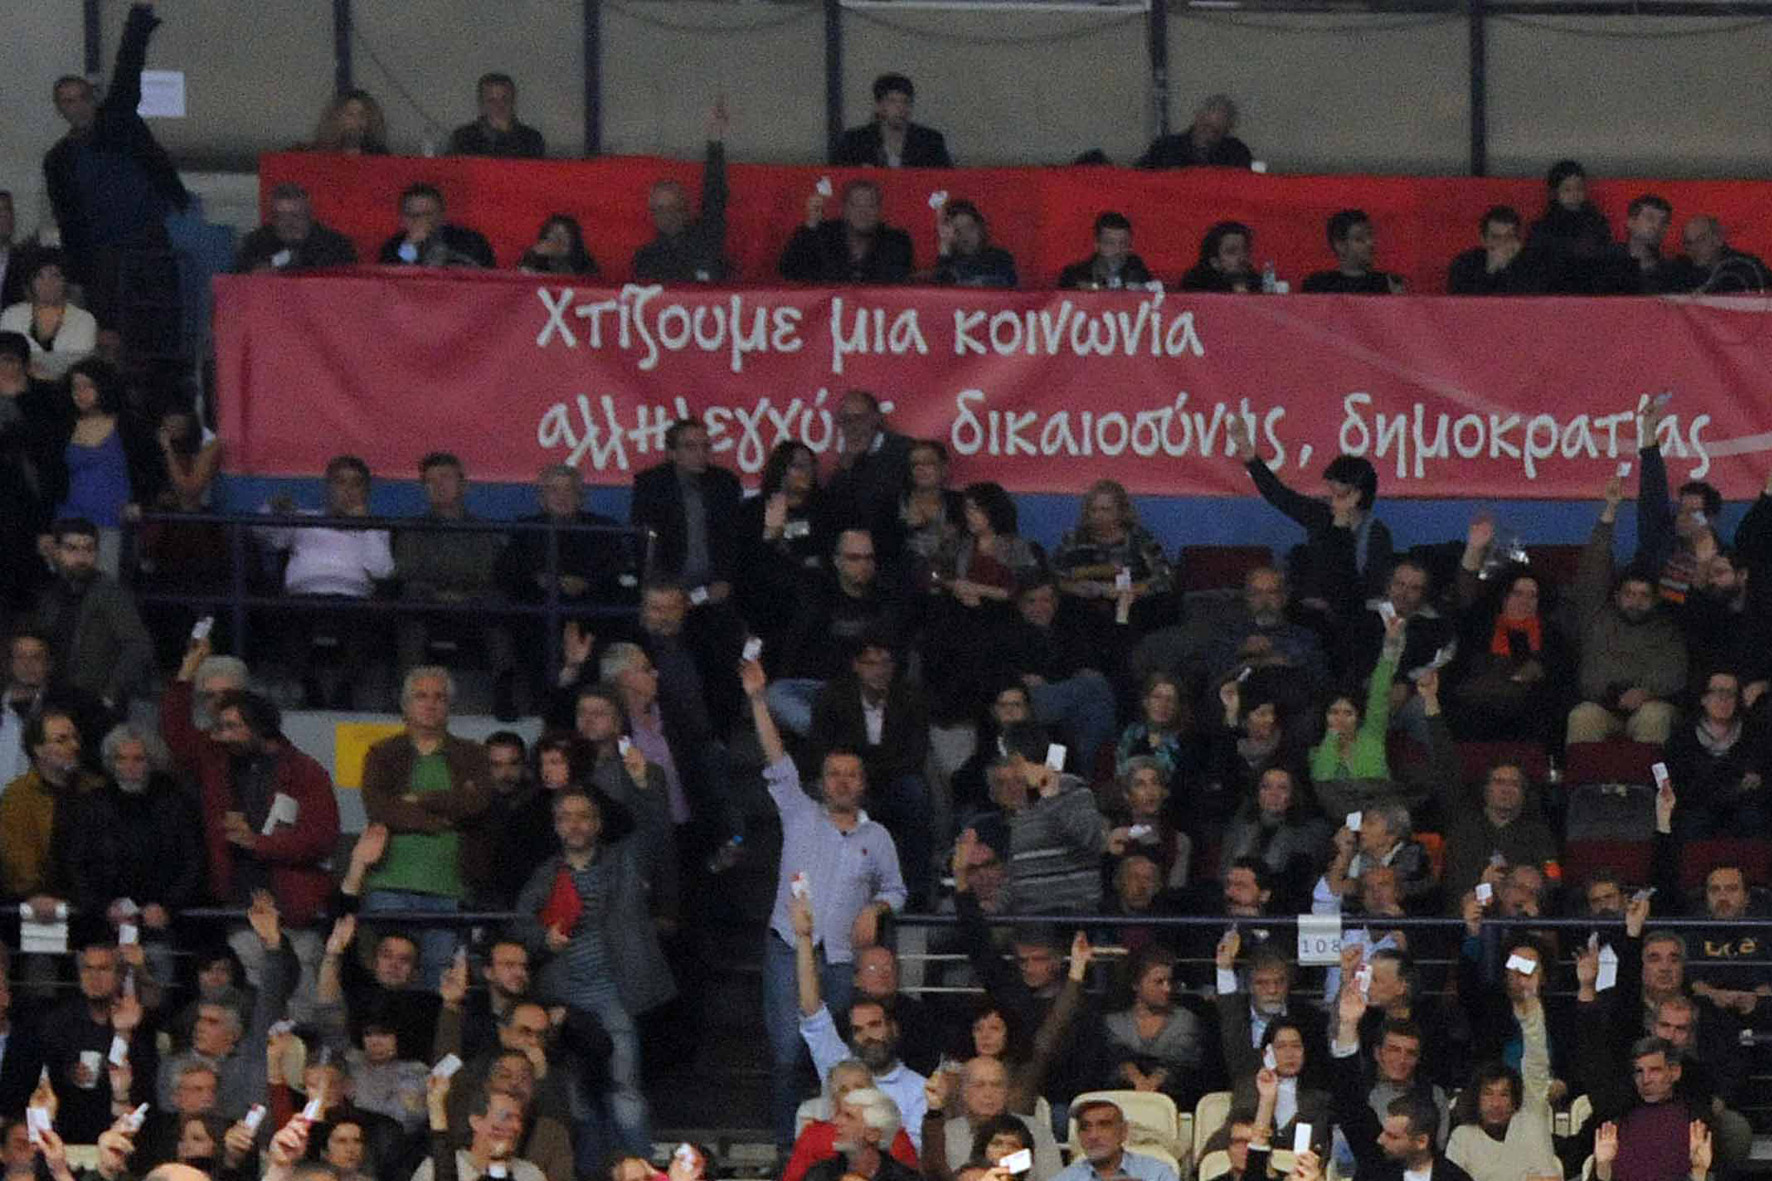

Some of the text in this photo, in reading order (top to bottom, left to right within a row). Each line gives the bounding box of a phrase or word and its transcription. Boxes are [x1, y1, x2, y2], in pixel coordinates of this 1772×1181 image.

[536, 280, 1205, 375] Χτίζουμε μια κοινωνία
[1337, 391, 1711, 480] δημοκρατίας
[1302, 938, 1341, 954] 108
